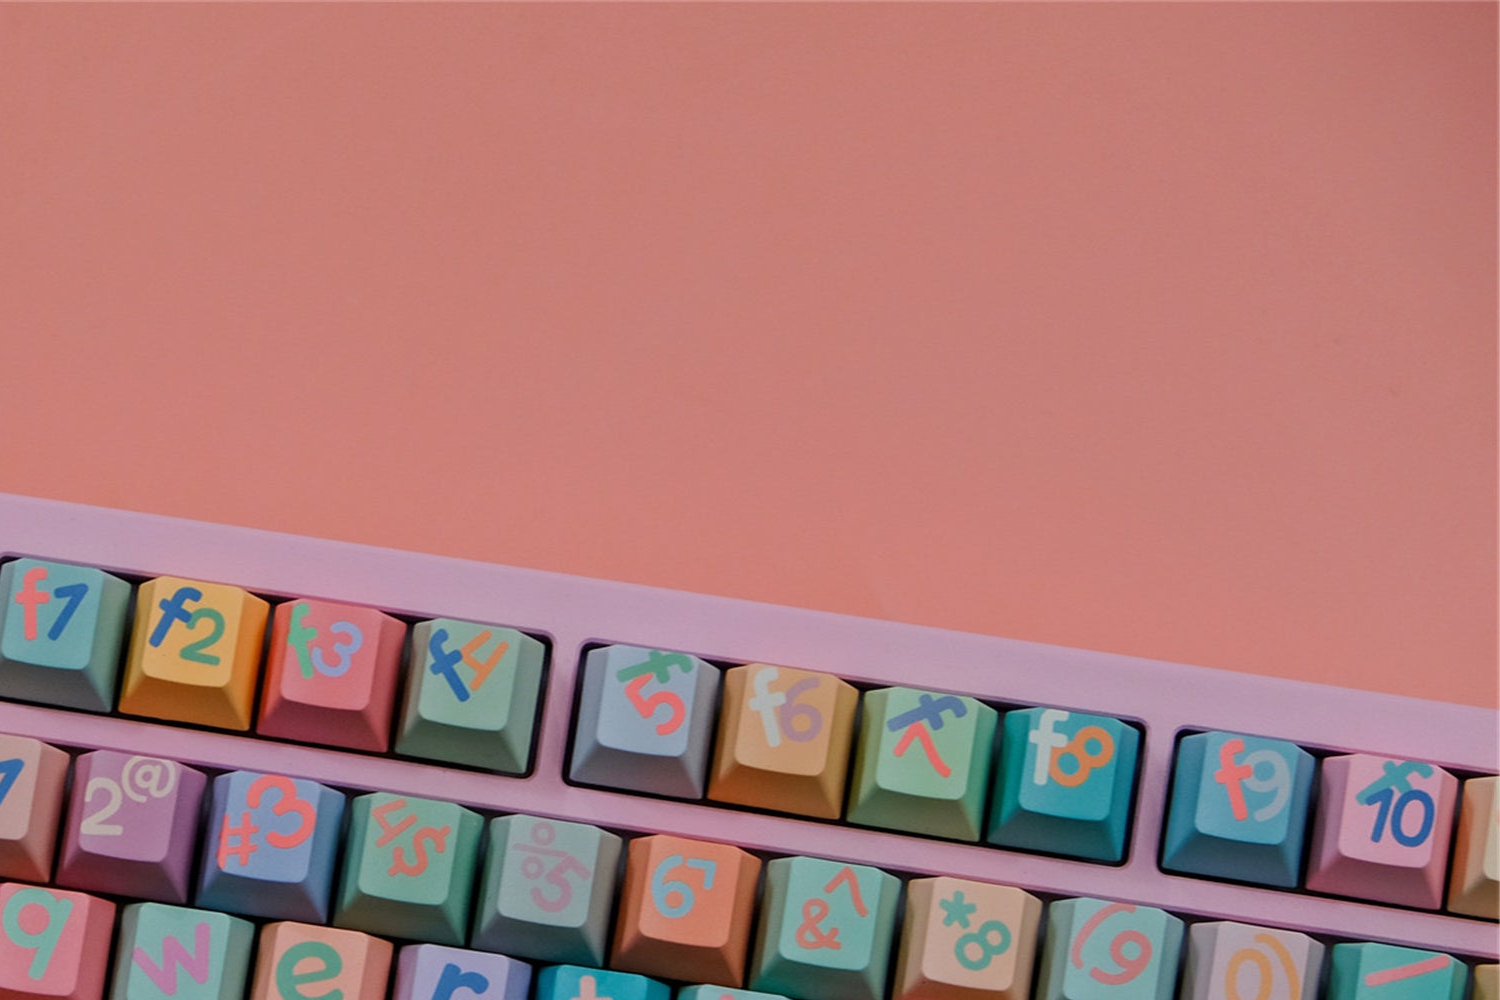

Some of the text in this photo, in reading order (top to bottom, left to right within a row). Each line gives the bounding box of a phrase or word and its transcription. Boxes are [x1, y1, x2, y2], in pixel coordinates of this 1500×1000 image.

[14, 567, 90, 642] f1
[149, 586, 226, 667] f2
[287, 602, 363, 679] f3
[429, 628, 510, 703] f4
[749, 667, 823, 748] f6
[1028, 708, 1115, 788] f8
[1214, 738, 1291, 823] f9
[2, 888, 74, 981] q
